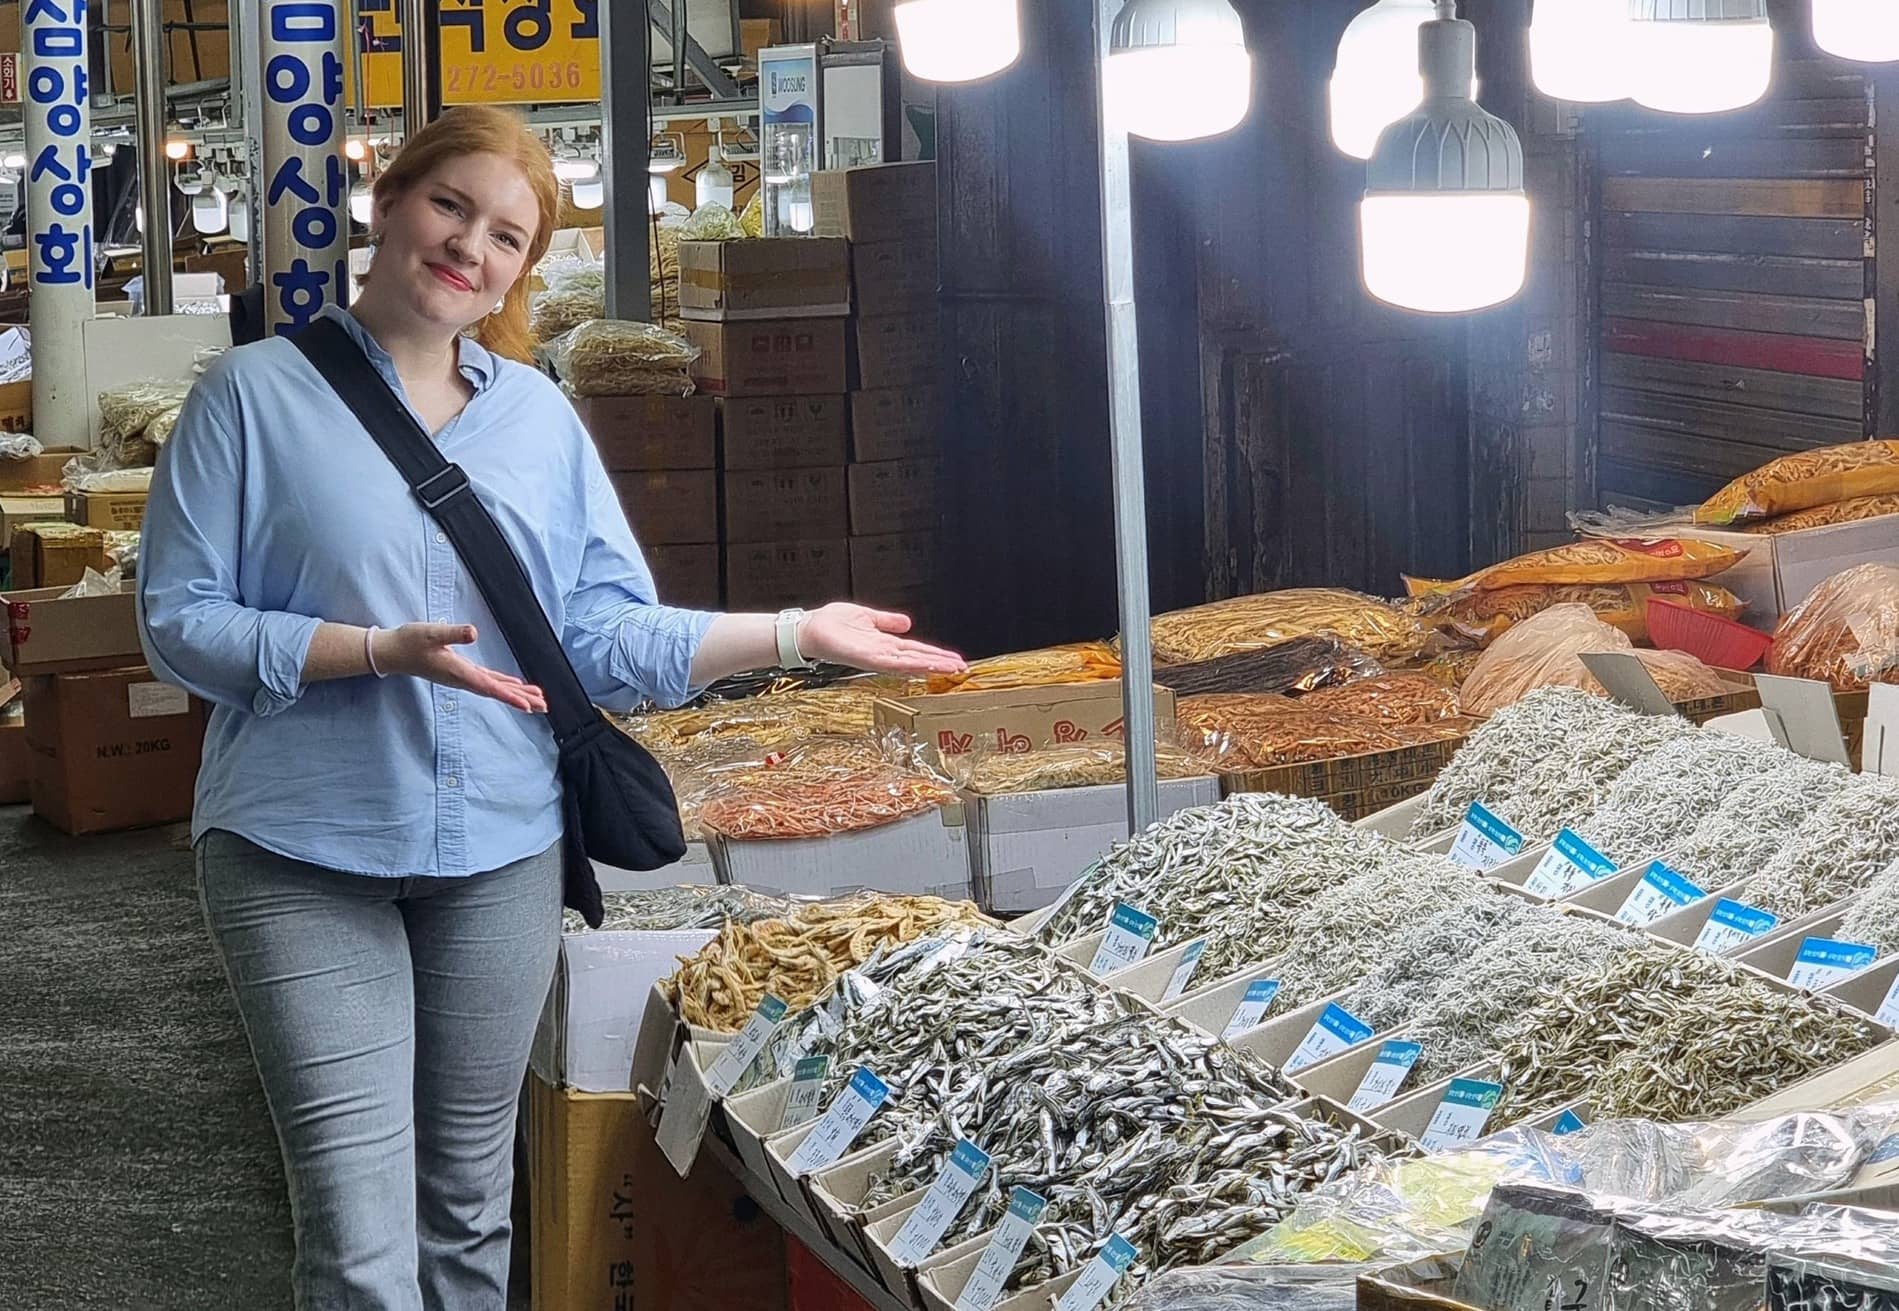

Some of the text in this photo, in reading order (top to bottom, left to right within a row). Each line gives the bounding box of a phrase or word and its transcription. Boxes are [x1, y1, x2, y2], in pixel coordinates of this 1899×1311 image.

[2, 56, 14, 89] 소화기
[447, 61, 583, 92] 272-5036
[777, 75, 806, 93] WOOSUNG
[24, 0, 93, 290] 삼양상회
[135, 738, 171, 754] 20KG
